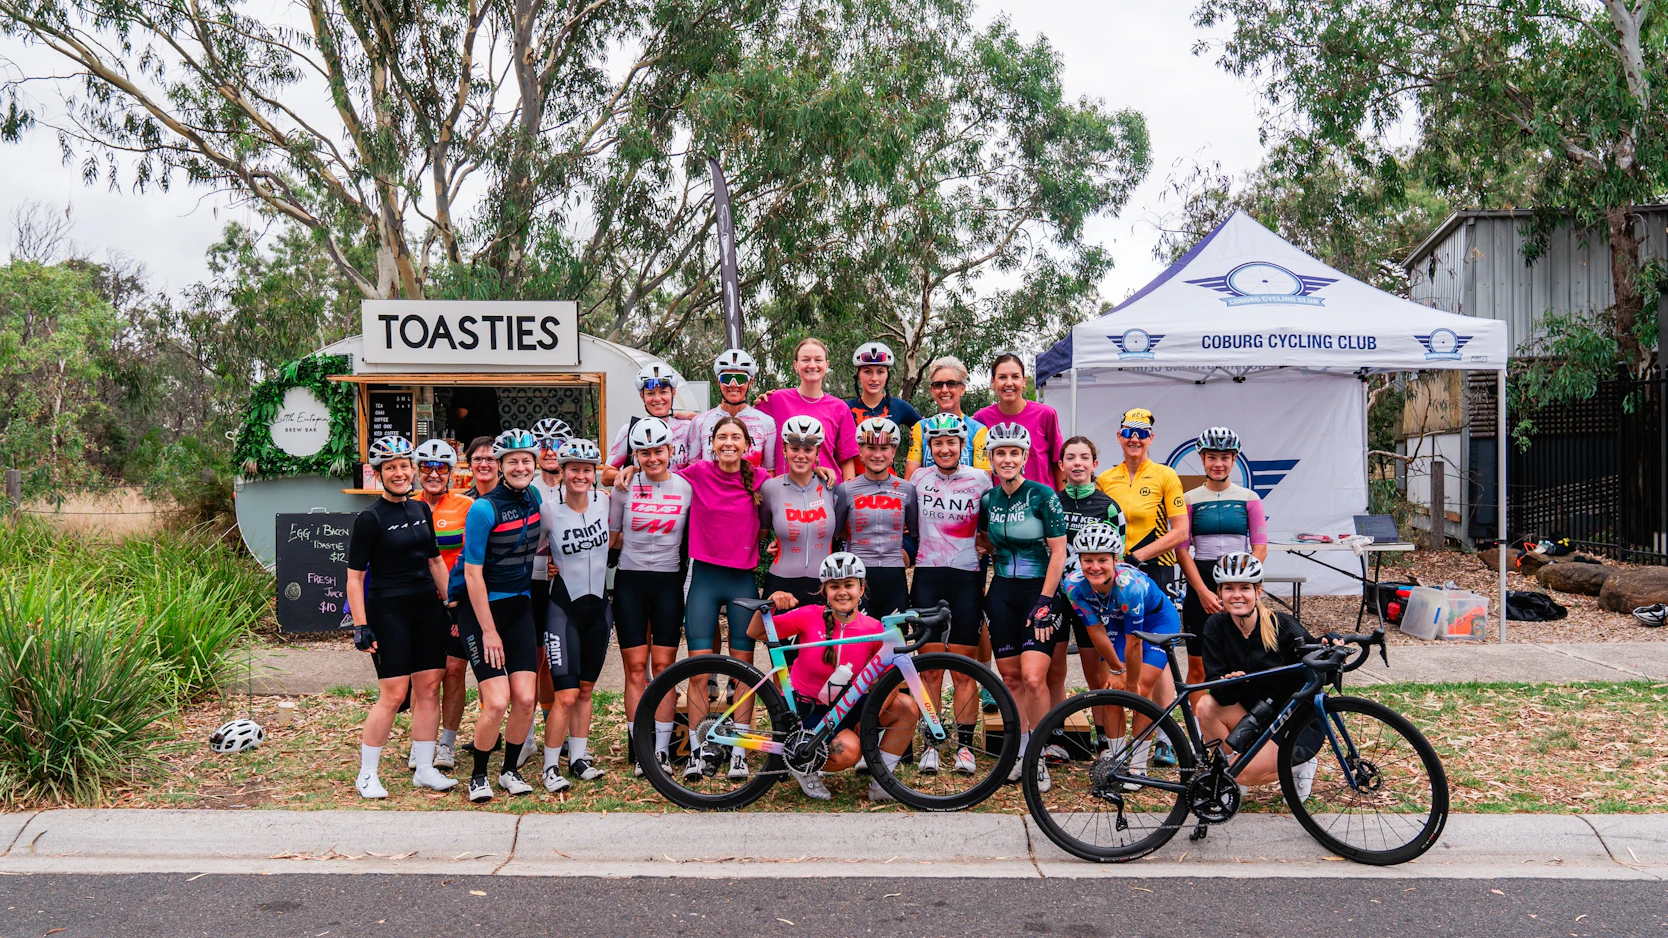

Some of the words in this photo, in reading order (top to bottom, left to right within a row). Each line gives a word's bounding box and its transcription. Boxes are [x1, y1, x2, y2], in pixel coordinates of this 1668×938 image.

[1229, 296, 1261, 305] COBURG
[1262, 294, 1296, 303] CYCLING
[1297, 296, 1320, 305] CLUB
[378, 314, 561, 350] TOASTIES
[1201, 334, 1263, 349] COBURG
[1268, 334, 1333, 349] CYCLING
[1338, 335, 1377, 350] CLUB
[854, 494, 902, 511] DUDA
[923, 494, 975, 511] PANA
[502, 509, 519, 522] RCC
[785, 506, 827, 523] DUDA
[990, 511, 1025, 523] RACING
[288, 523, 310, 542] EGG
[323, 524, 350, 537] BACON
[562, 519, 602, 541] SAINT
[312, 540, 345, 551] TOASTIE
[329, 551, 348, 564] $12
[307, 572, 337, 587] FRESH
[323, 586, 344, 598] JUICE
[318, 601, 337, 614] $10
[466, 634, 481, 667] RAPHA
[549, 633, 562, 666] SAINT
[823, 654, 887, 724] FACTOR
[924, 702, 939, 725] OSTRO
[676, 725, 691, 757] 2
